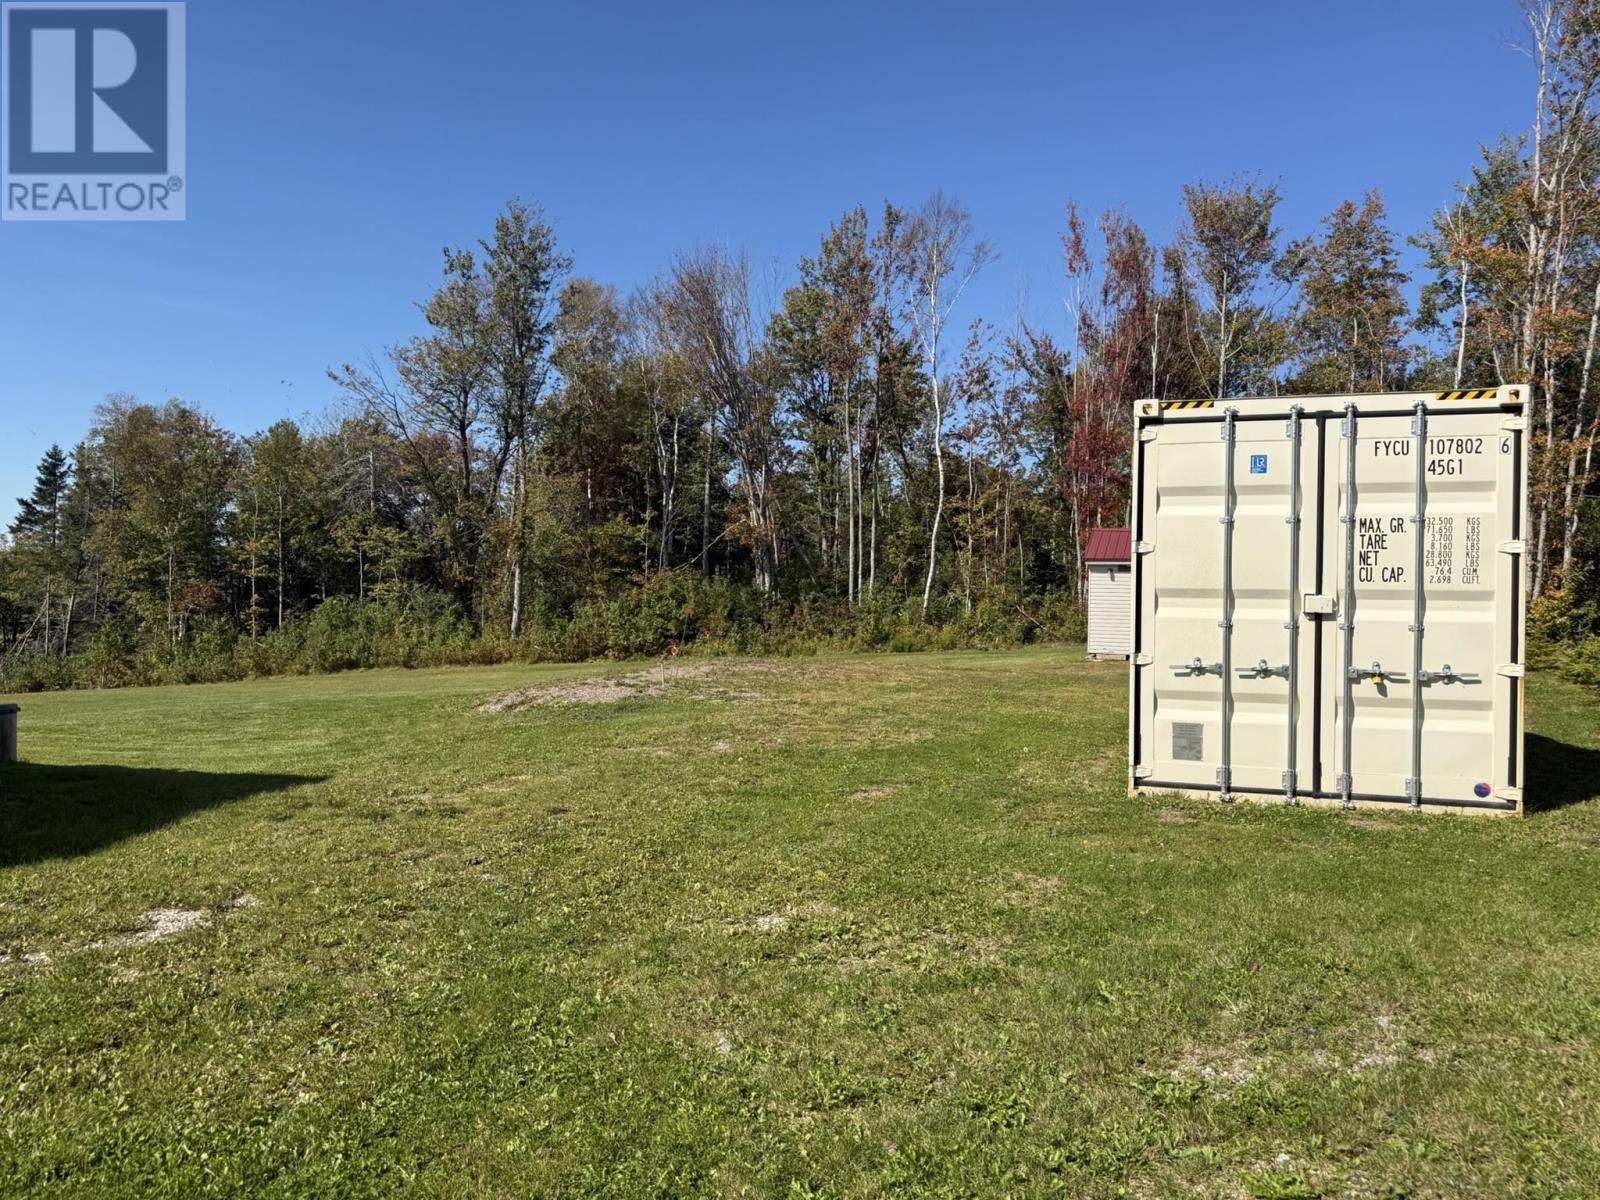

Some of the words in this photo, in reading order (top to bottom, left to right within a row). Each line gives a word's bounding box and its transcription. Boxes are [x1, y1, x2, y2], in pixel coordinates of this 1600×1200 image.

[1374, 440, 1410, 457] FYCU
[1429, 438, 1483, 455] 107802
[1501, 437, 1510, 454] 6
[1427, 458, 1463, 475] 45G1
[1359, 517, 1385, 534] MAX.
[1390, 517, 1407, 533] GR.
[1426, 517, 1453, 526] 32.500
[1466, 517, 1480, 526] KGS
[1466, 525, 1480, 534] LBS
[1359, 534, 1388, 550] TARE
[1466, 533, 1480, 542] KGS
[1466, 542, 1480, 551] LBS
[1359, 550, 1379, 566] NET
[1466, 550, 1480, 559] KGS
[1465, 559, 1480, 567] LBS
[1358, 567, 1375, 583] CU.
[1381, 567, 1406, 583] CAP.
